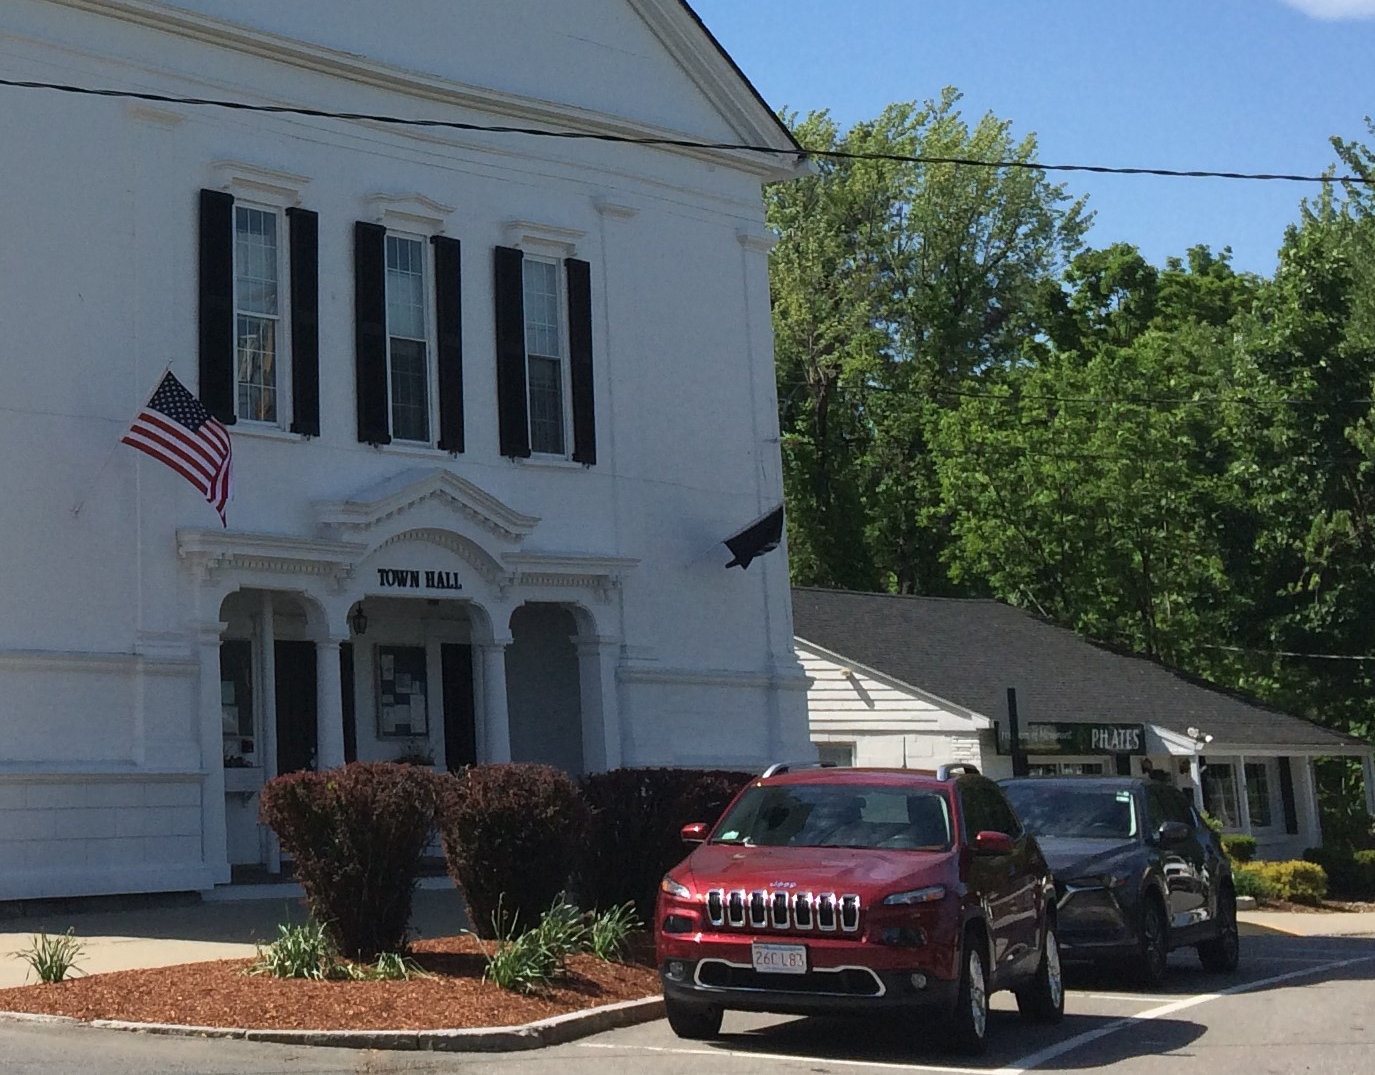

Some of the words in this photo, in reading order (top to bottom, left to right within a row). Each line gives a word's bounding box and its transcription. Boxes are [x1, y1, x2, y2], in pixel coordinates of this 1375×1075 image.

[377, 568, 420, 588] TOWN
[425, 570, 463, 590] HALL
[1091, 728, 1140, 750] PILATES
